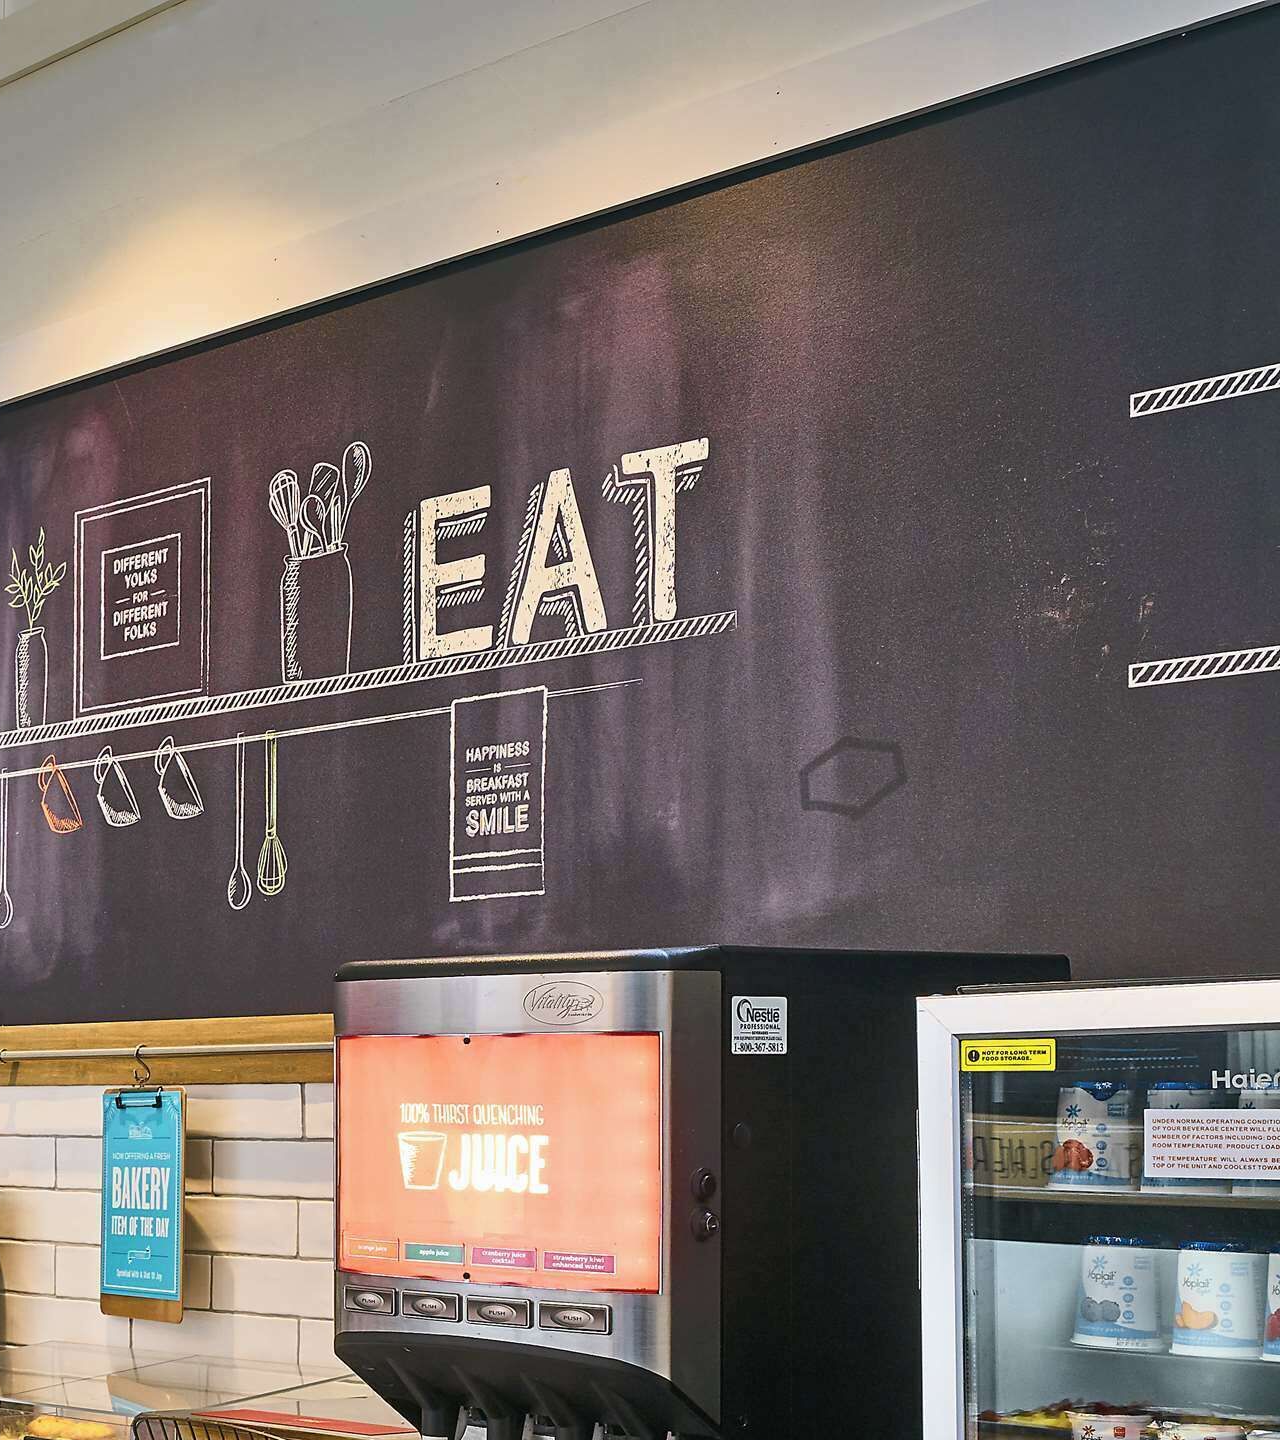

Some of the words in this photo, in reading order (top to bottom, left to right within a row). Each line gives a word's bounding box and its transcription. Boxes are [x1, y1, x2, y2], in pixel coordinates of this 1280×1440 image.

[402, 437, 709, 661] EAT
[113, 548, 168, 574] DIFFERENT
[125, 568, 158, 588] YOLKS
[133, 591, 148, 604] FOR
[113, 601, 168, 626] DIFFERENT
[125, 620, 157, 640] FOLKS
[466, 741, 530, 764] HAPPINESS
[493, 763, 502, 774] IS
[466, 772, 530, 793] BREAKFAST
[465, 793, 497, 808] SERVED
[500, 791, 520, 805] WITH
[523, 790, 531, 801] A
[466, 804, 529, 837] SMILE
[399, 1102, 430, 1125] 100%
[432, 1103, 470, 1126] THIRST
[473, 1103, 544, 1128] QUENCHING
[125, 1152, 149, 1160] OFFERING
[154, 1152, 170, 1160] FRESH
[448, 1133, 549, 1194] JUICE
[112, 1167, 171, 1211] BAKERY
[112, 1216, 128, 1235] ITEM
[129, 1217, 139, 1236] OF
[140, 1217, 154, 1237] THE
[156, 1217, 169, 1238] DAY
[435, 1249, 449, 1257] juice
[482, 1250, 510, 1258] cranberry
[492, 1257, 515, 1265] cocktail
[553, 1255, 587, 1263] strawberry
[552, 1261, 582, 1269] enhanced
[1088, 1269, 1116, 1282] Yoplait
[1182, 1276, 1211, 1289] Yoplait
